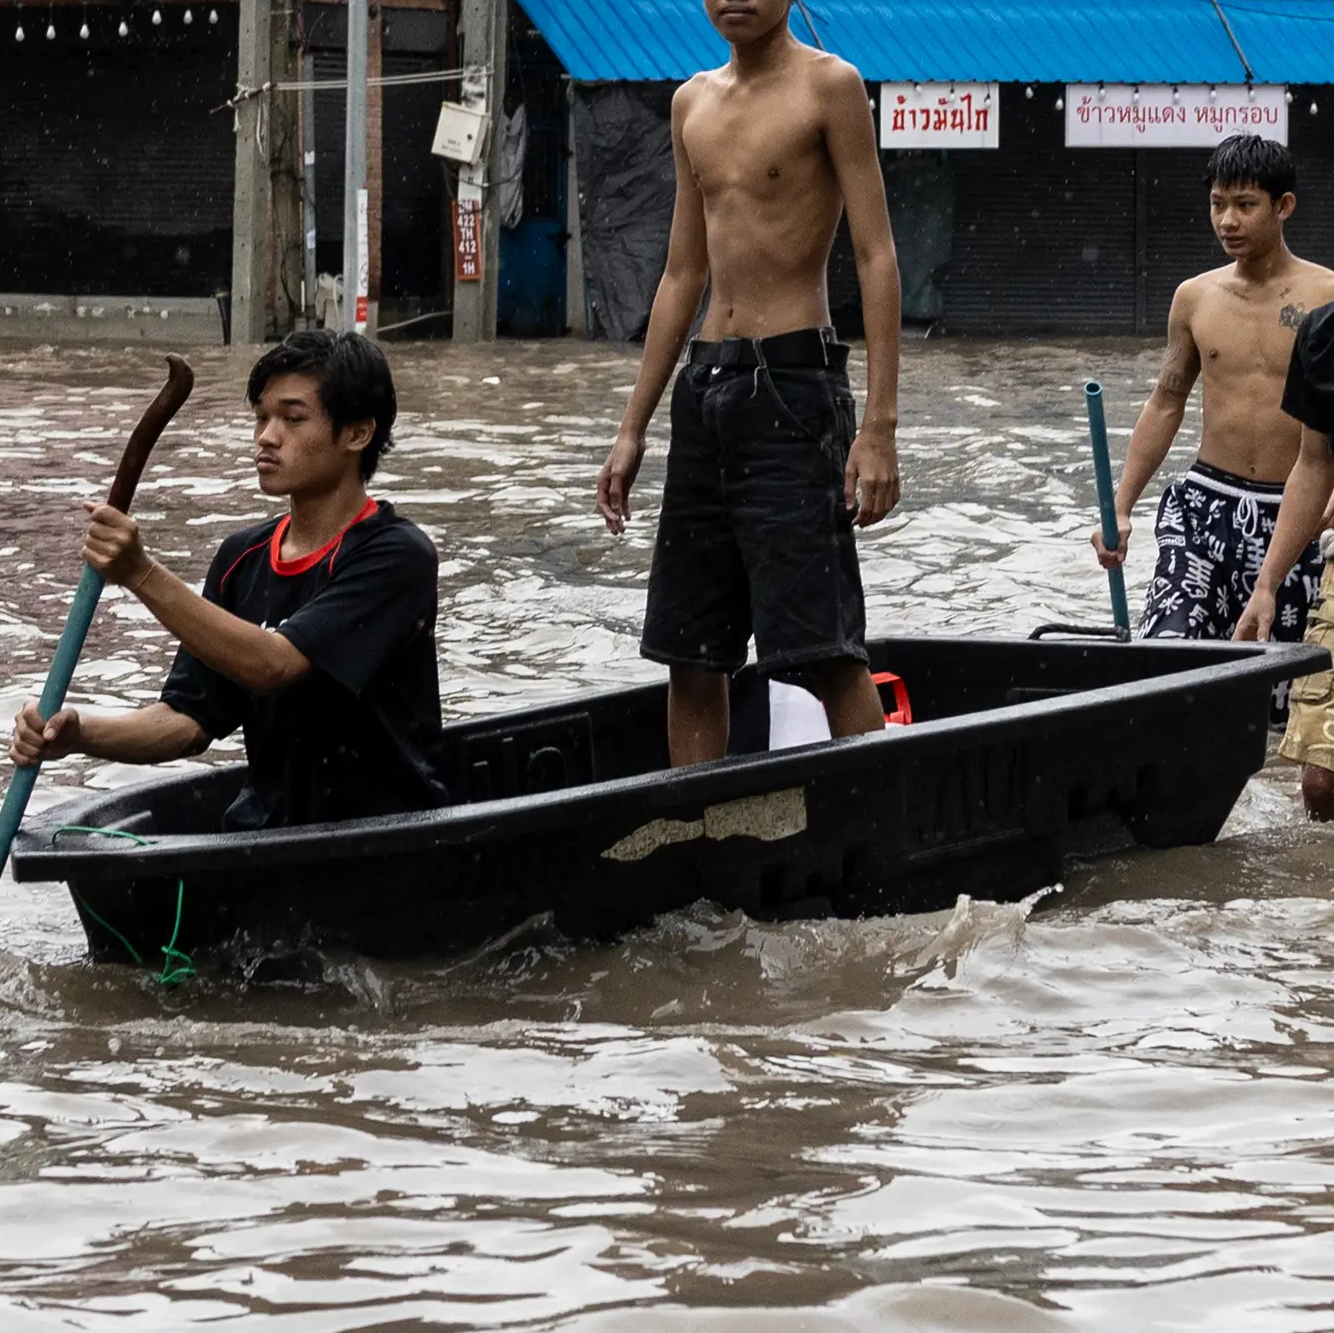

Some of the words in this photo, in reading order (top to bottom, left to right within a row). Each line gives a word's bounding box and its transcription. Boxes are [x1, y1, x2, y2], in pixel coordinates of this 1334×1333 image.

[892, 92, 989, 135] ข้าวมันไก
[1076, 96, 1187, 133] ข้าวหมูแดง
[1194, 104, 1280, 134] หมูกรอบ
